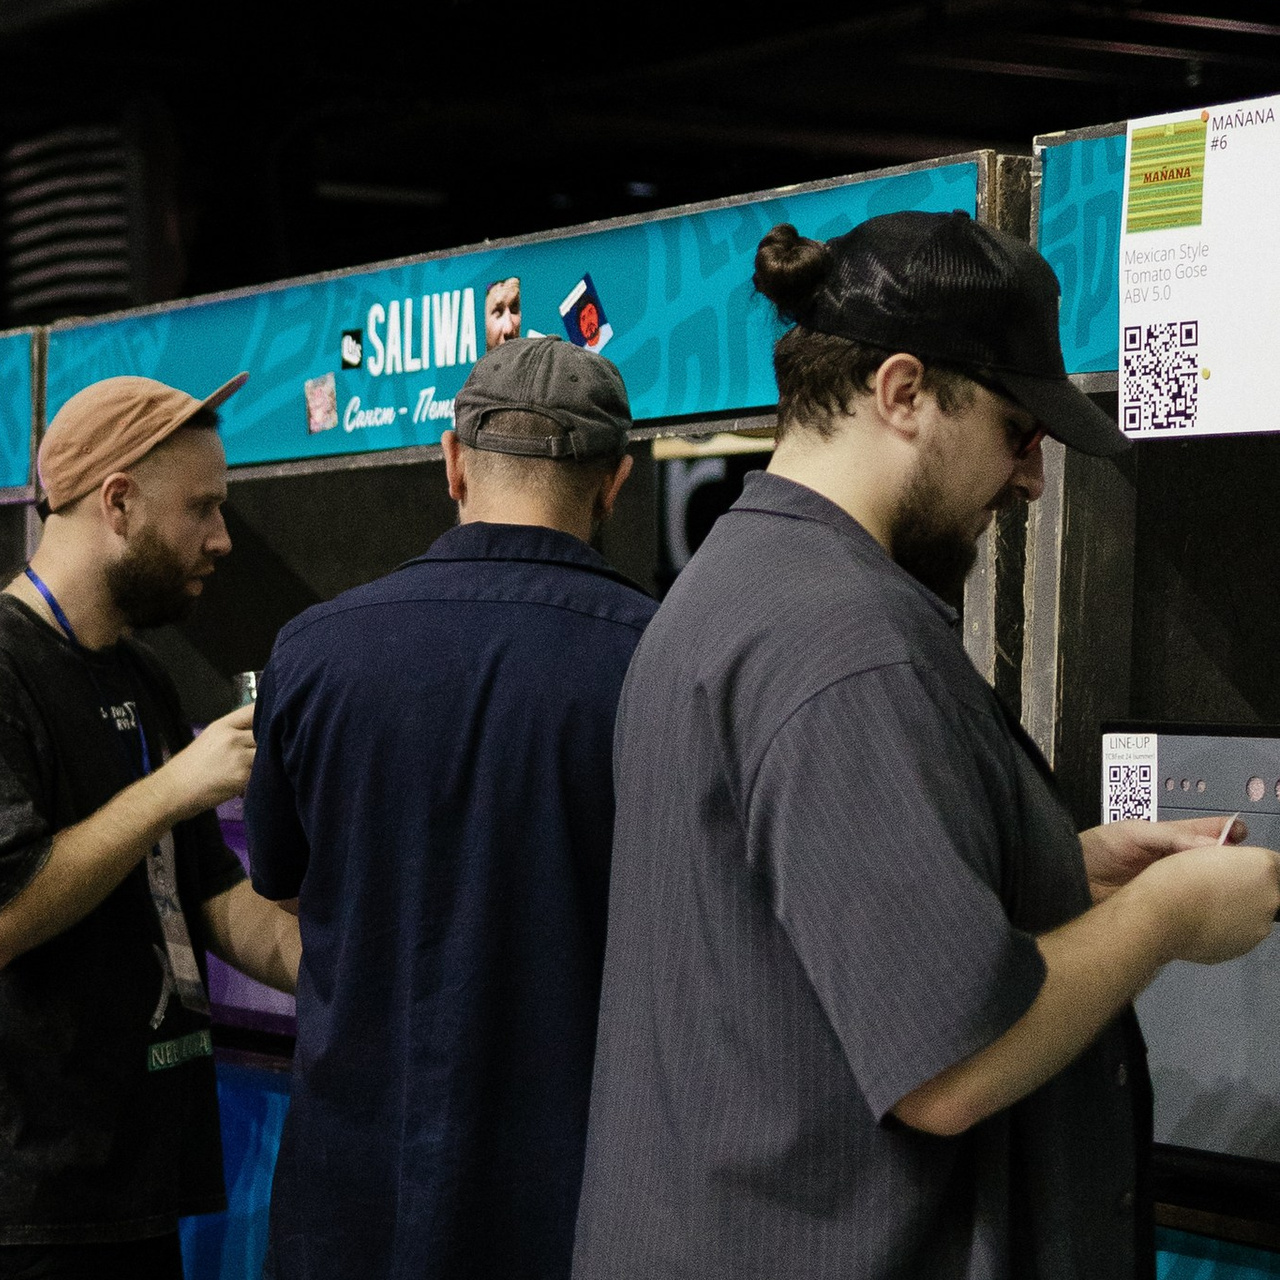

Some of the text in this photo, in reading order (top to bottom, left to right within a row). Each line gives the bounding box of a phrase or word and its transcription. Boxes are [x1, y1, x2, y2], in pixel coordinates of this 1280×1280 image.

[1211, 107, 1276, 132] MAÑANA
[1210, 133, 1228, 151] #6
[1143, 166, 1191, 184] MAÑANA
[1124, 241, 1209, 265] Mexican Style
[1124, 262, 1208, 285] Tomato Gose
[1123, 283, 1171, 304] ABV 5.0
[367, 287, 477, 377] SALIWA
[1109, 736, 1150, 749] LINE-UP
